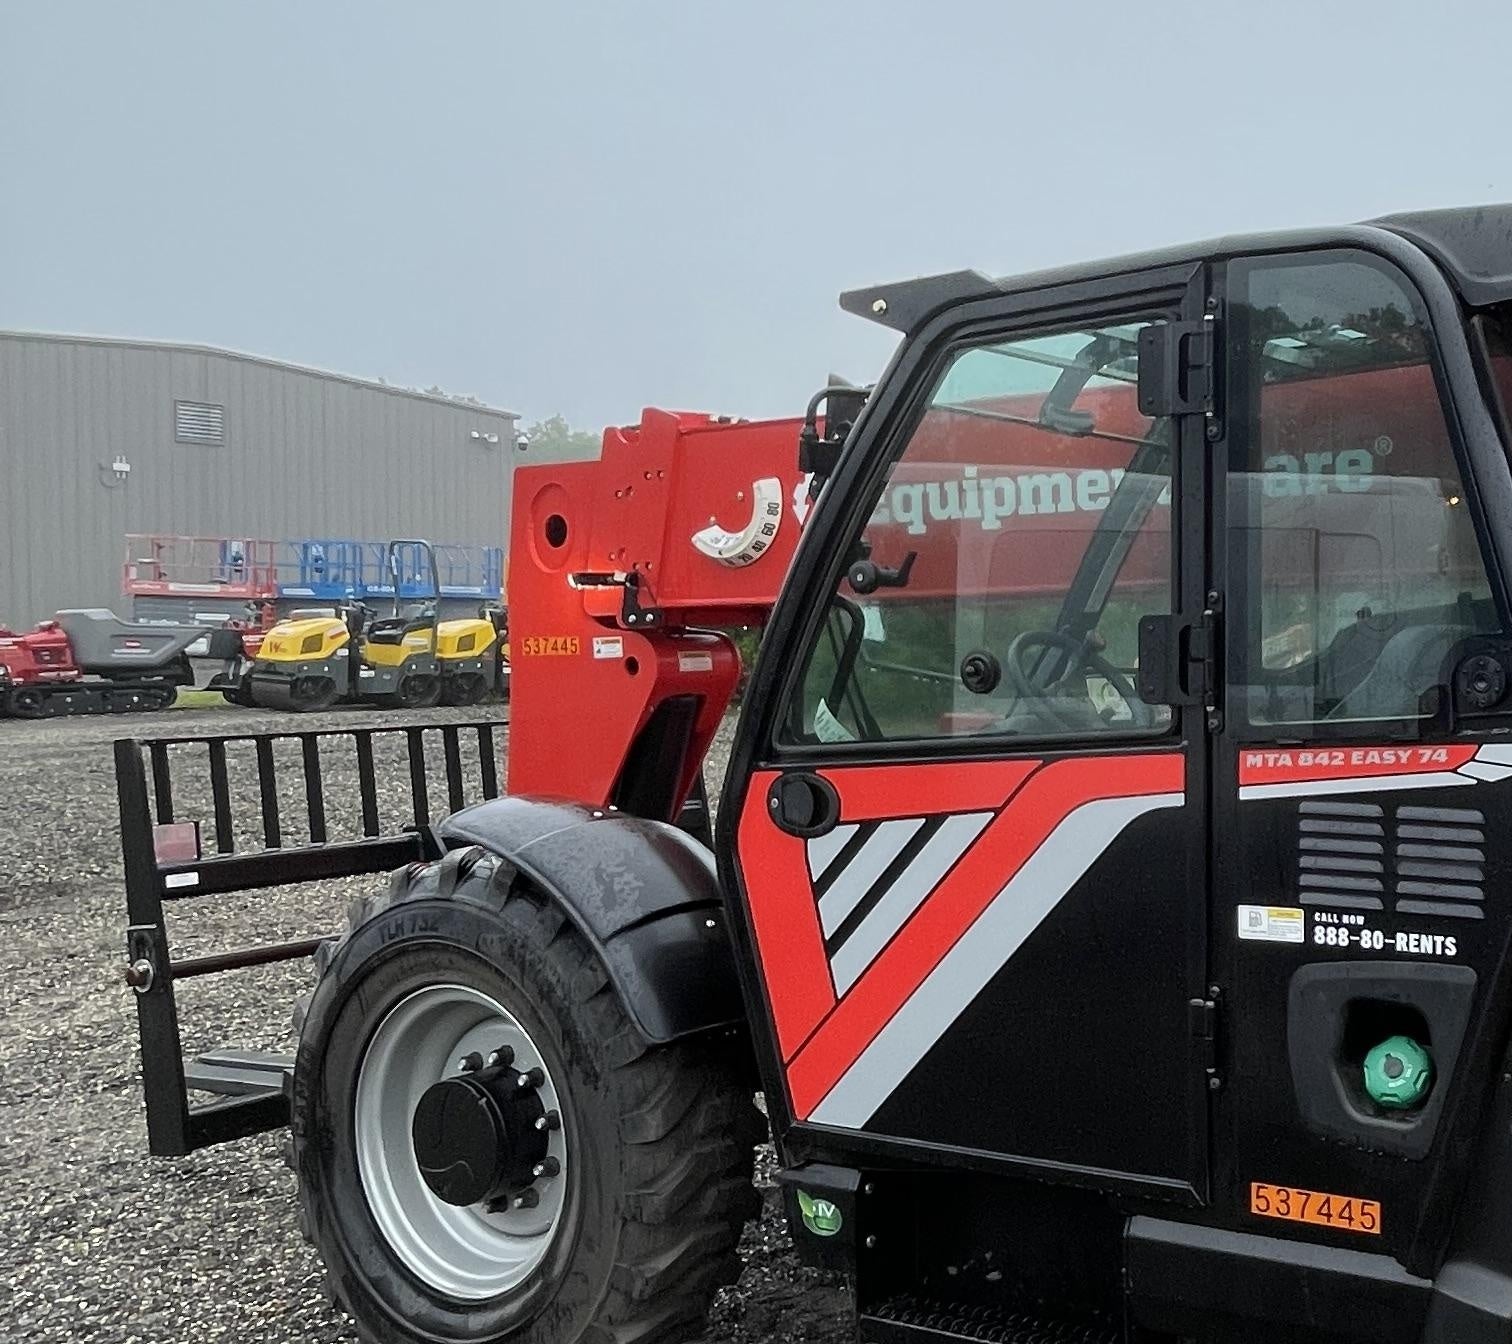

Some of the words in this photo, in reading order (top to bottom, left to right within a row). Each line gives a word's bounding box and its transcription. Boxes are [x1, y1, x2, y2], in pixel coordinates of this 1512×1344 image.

[766, 502, 780, 516] 80
[761, 522, 776, 537] 60
[752, 540, 767, 553] 40
[738, 553, 753, 564] 20
[523, 637, 579, 655] 537445
[1246, 752, 1293, 769] MTA
[1298, 750, 1345, 767] 842
[1351, 749, 1412, 766] EASY
[1417, 748, 1449, 764] 74
[1314, 911, 1340, 924] CALL
[1342, 913, 1366, 926] NOW
[1313, 925, 1458, 957] 888-80-RENTS
[818, 1203, 836, 1218] IV
[1255, 1185, 1376, 1230] 537445
